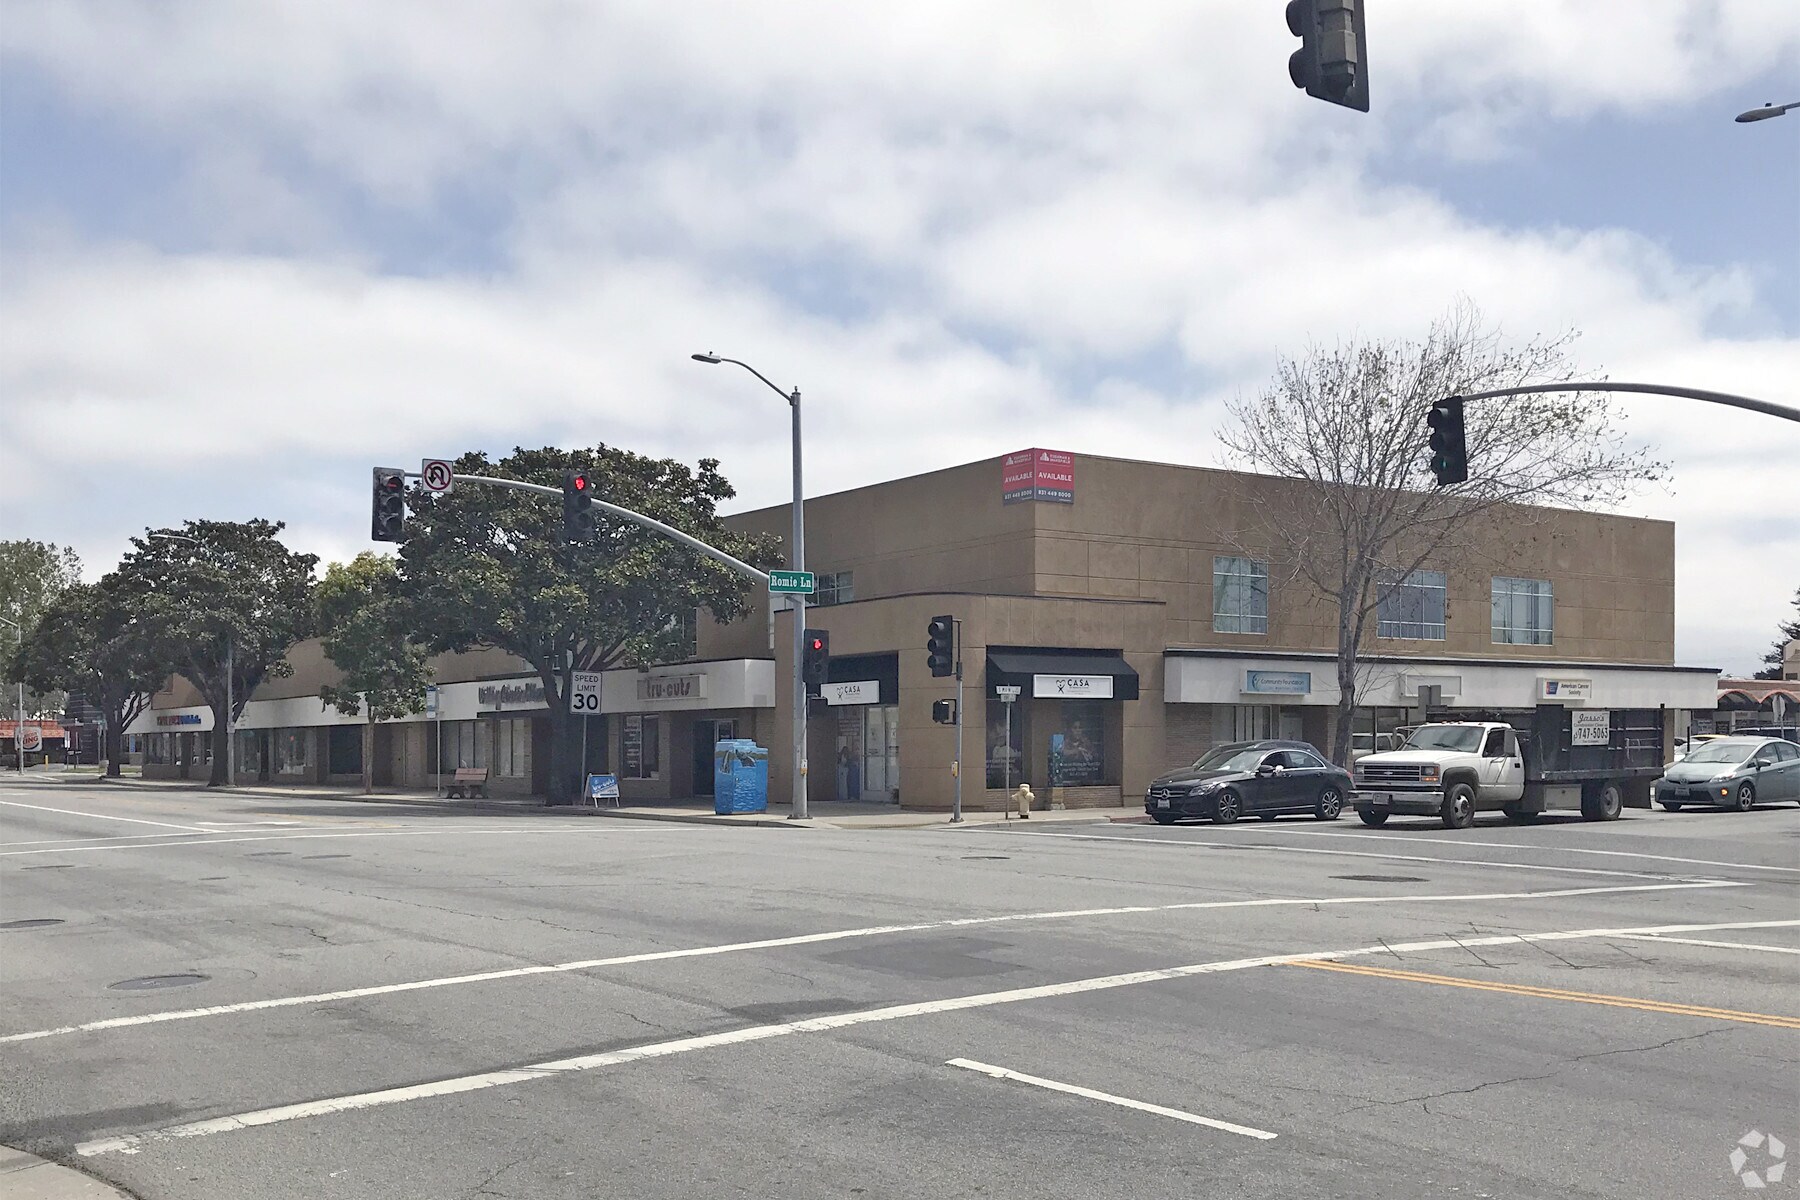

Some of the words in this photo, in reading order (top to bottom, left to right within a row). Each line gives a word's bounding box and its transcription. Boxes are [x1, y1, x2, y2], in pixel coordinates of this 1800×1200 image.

[1005, 472, 1033, 483] AVAILABLE
[1038, 472, 1072, 481] AVAILABLE
[771, 575, 797, 587] Romie
[800, 577, 811, 587] Ln
[574, 674, 599, 683] SPEED
[1067, 679, 1090, 687] CASA
[576, 684, 597, 692] LIMIT
[844, 685, 861, 694] CASA
[573, 693, 599, 711] 30
